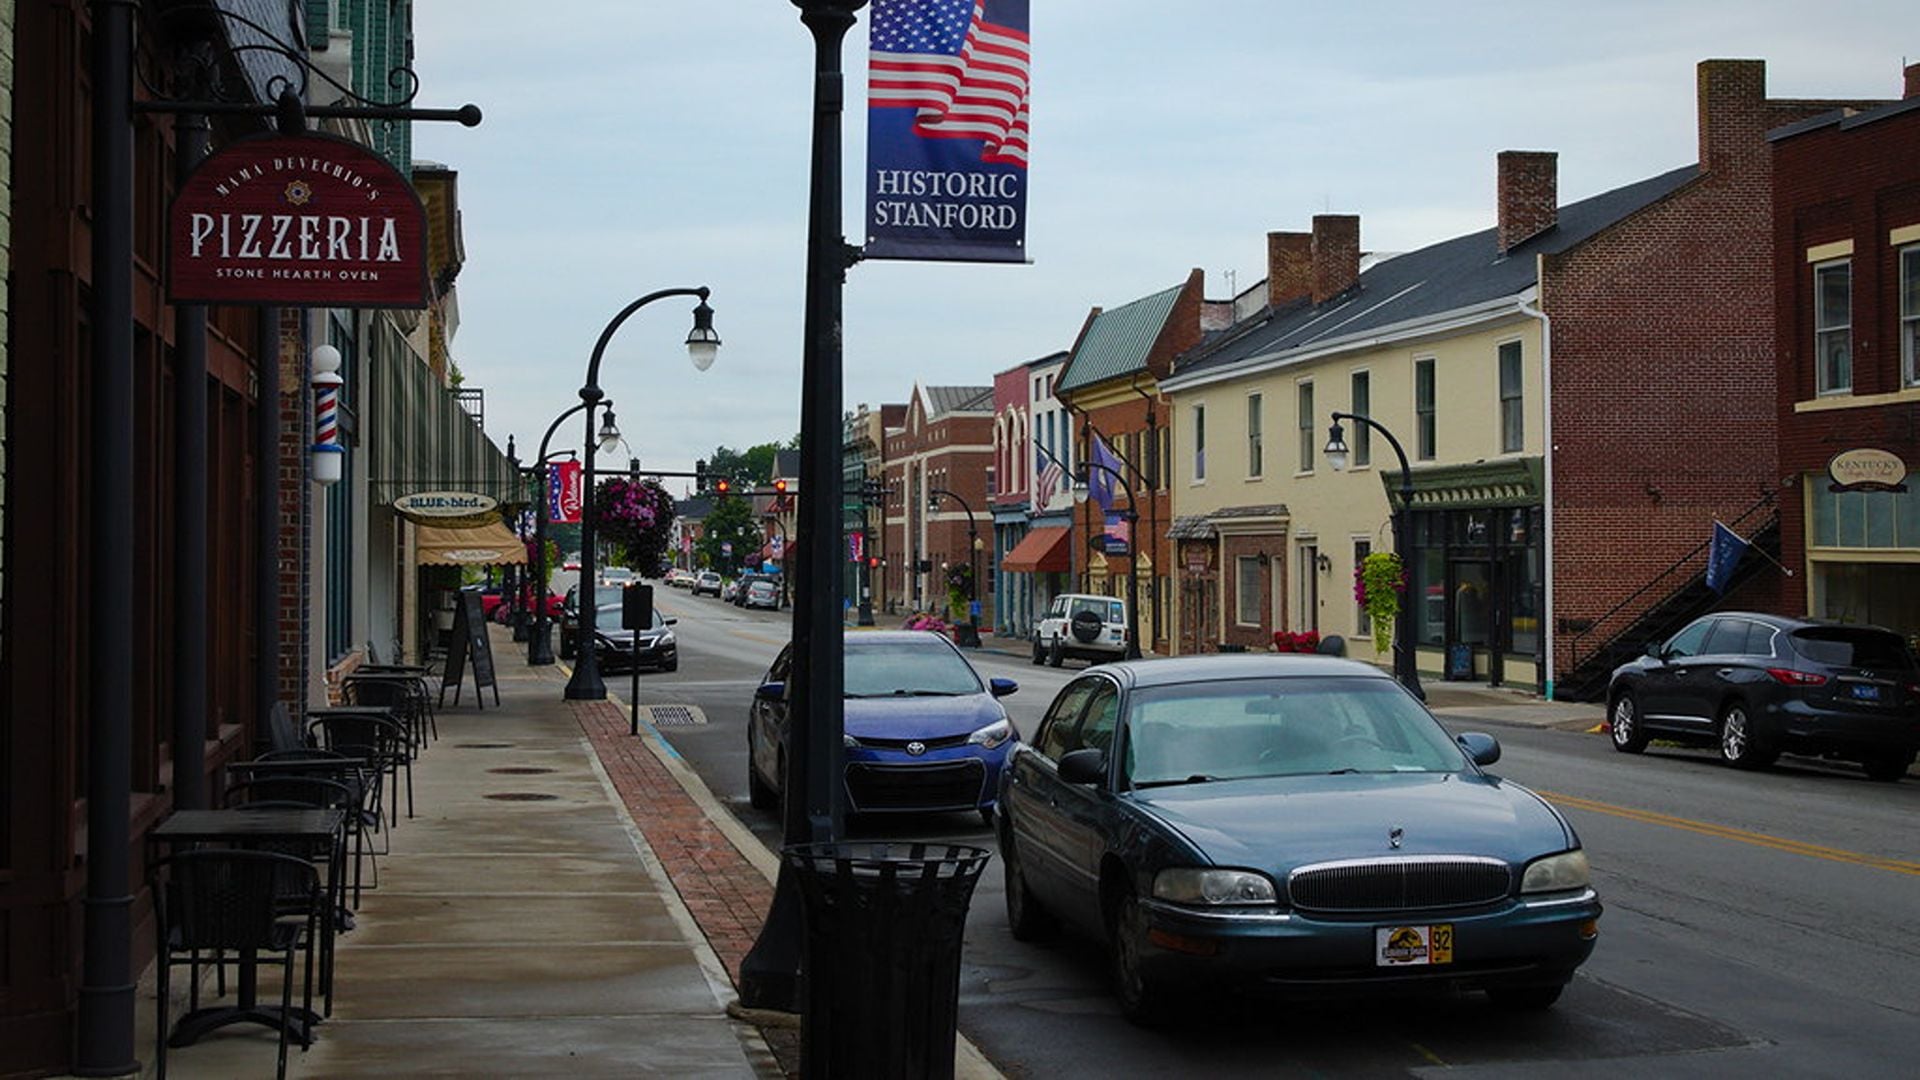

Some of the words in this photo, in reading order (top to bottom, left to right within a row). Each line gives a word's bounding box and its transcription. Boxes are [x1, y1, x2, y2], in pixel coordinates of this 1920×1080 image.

[215, 164, 264, 198] MAMA
[274, 157, 380, 201] DEVECHIO'S
[876, 169, 1018, 199] HISTORIC
[875, 200, 1017, 229] STANFORD
[189, 213, 402, 262] PIZZERIA
[216, 267, 265, 279] STONE
[272, 269, 331, 280] HEARTH
[338, 270, 379, 281] OVEN
[1836, 460, 1898, 470] KENTUCKY
[1433, 930, 1451, 952] 92
